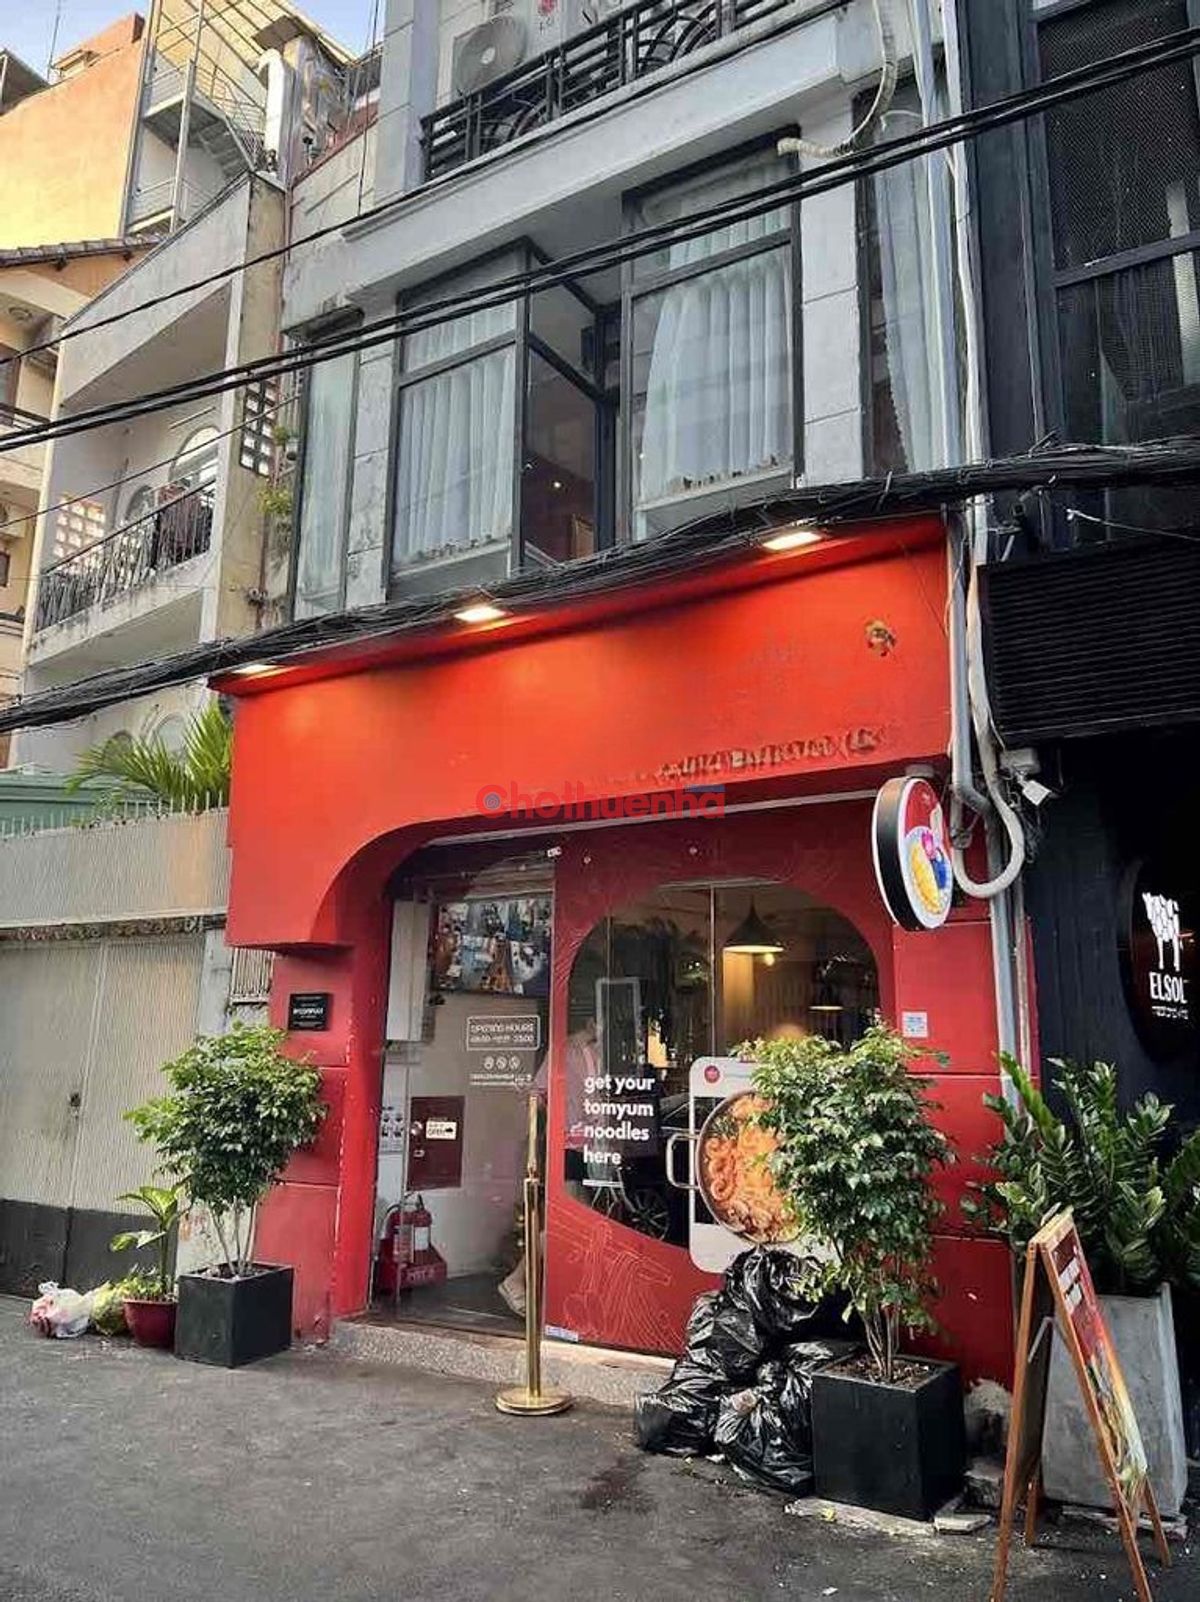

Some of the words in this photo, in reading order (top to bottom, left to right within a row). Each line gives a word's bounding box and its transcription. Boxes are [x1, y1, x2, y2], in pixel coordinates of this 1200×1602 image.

[584, 1074, 612, 1094] get
[614, 1077, 656, 1094] your
[583, 1099, 654, 1120] tomyum
[584, 1121, 650, 1140] noodles
[583, 1144, 621, 1165] here
